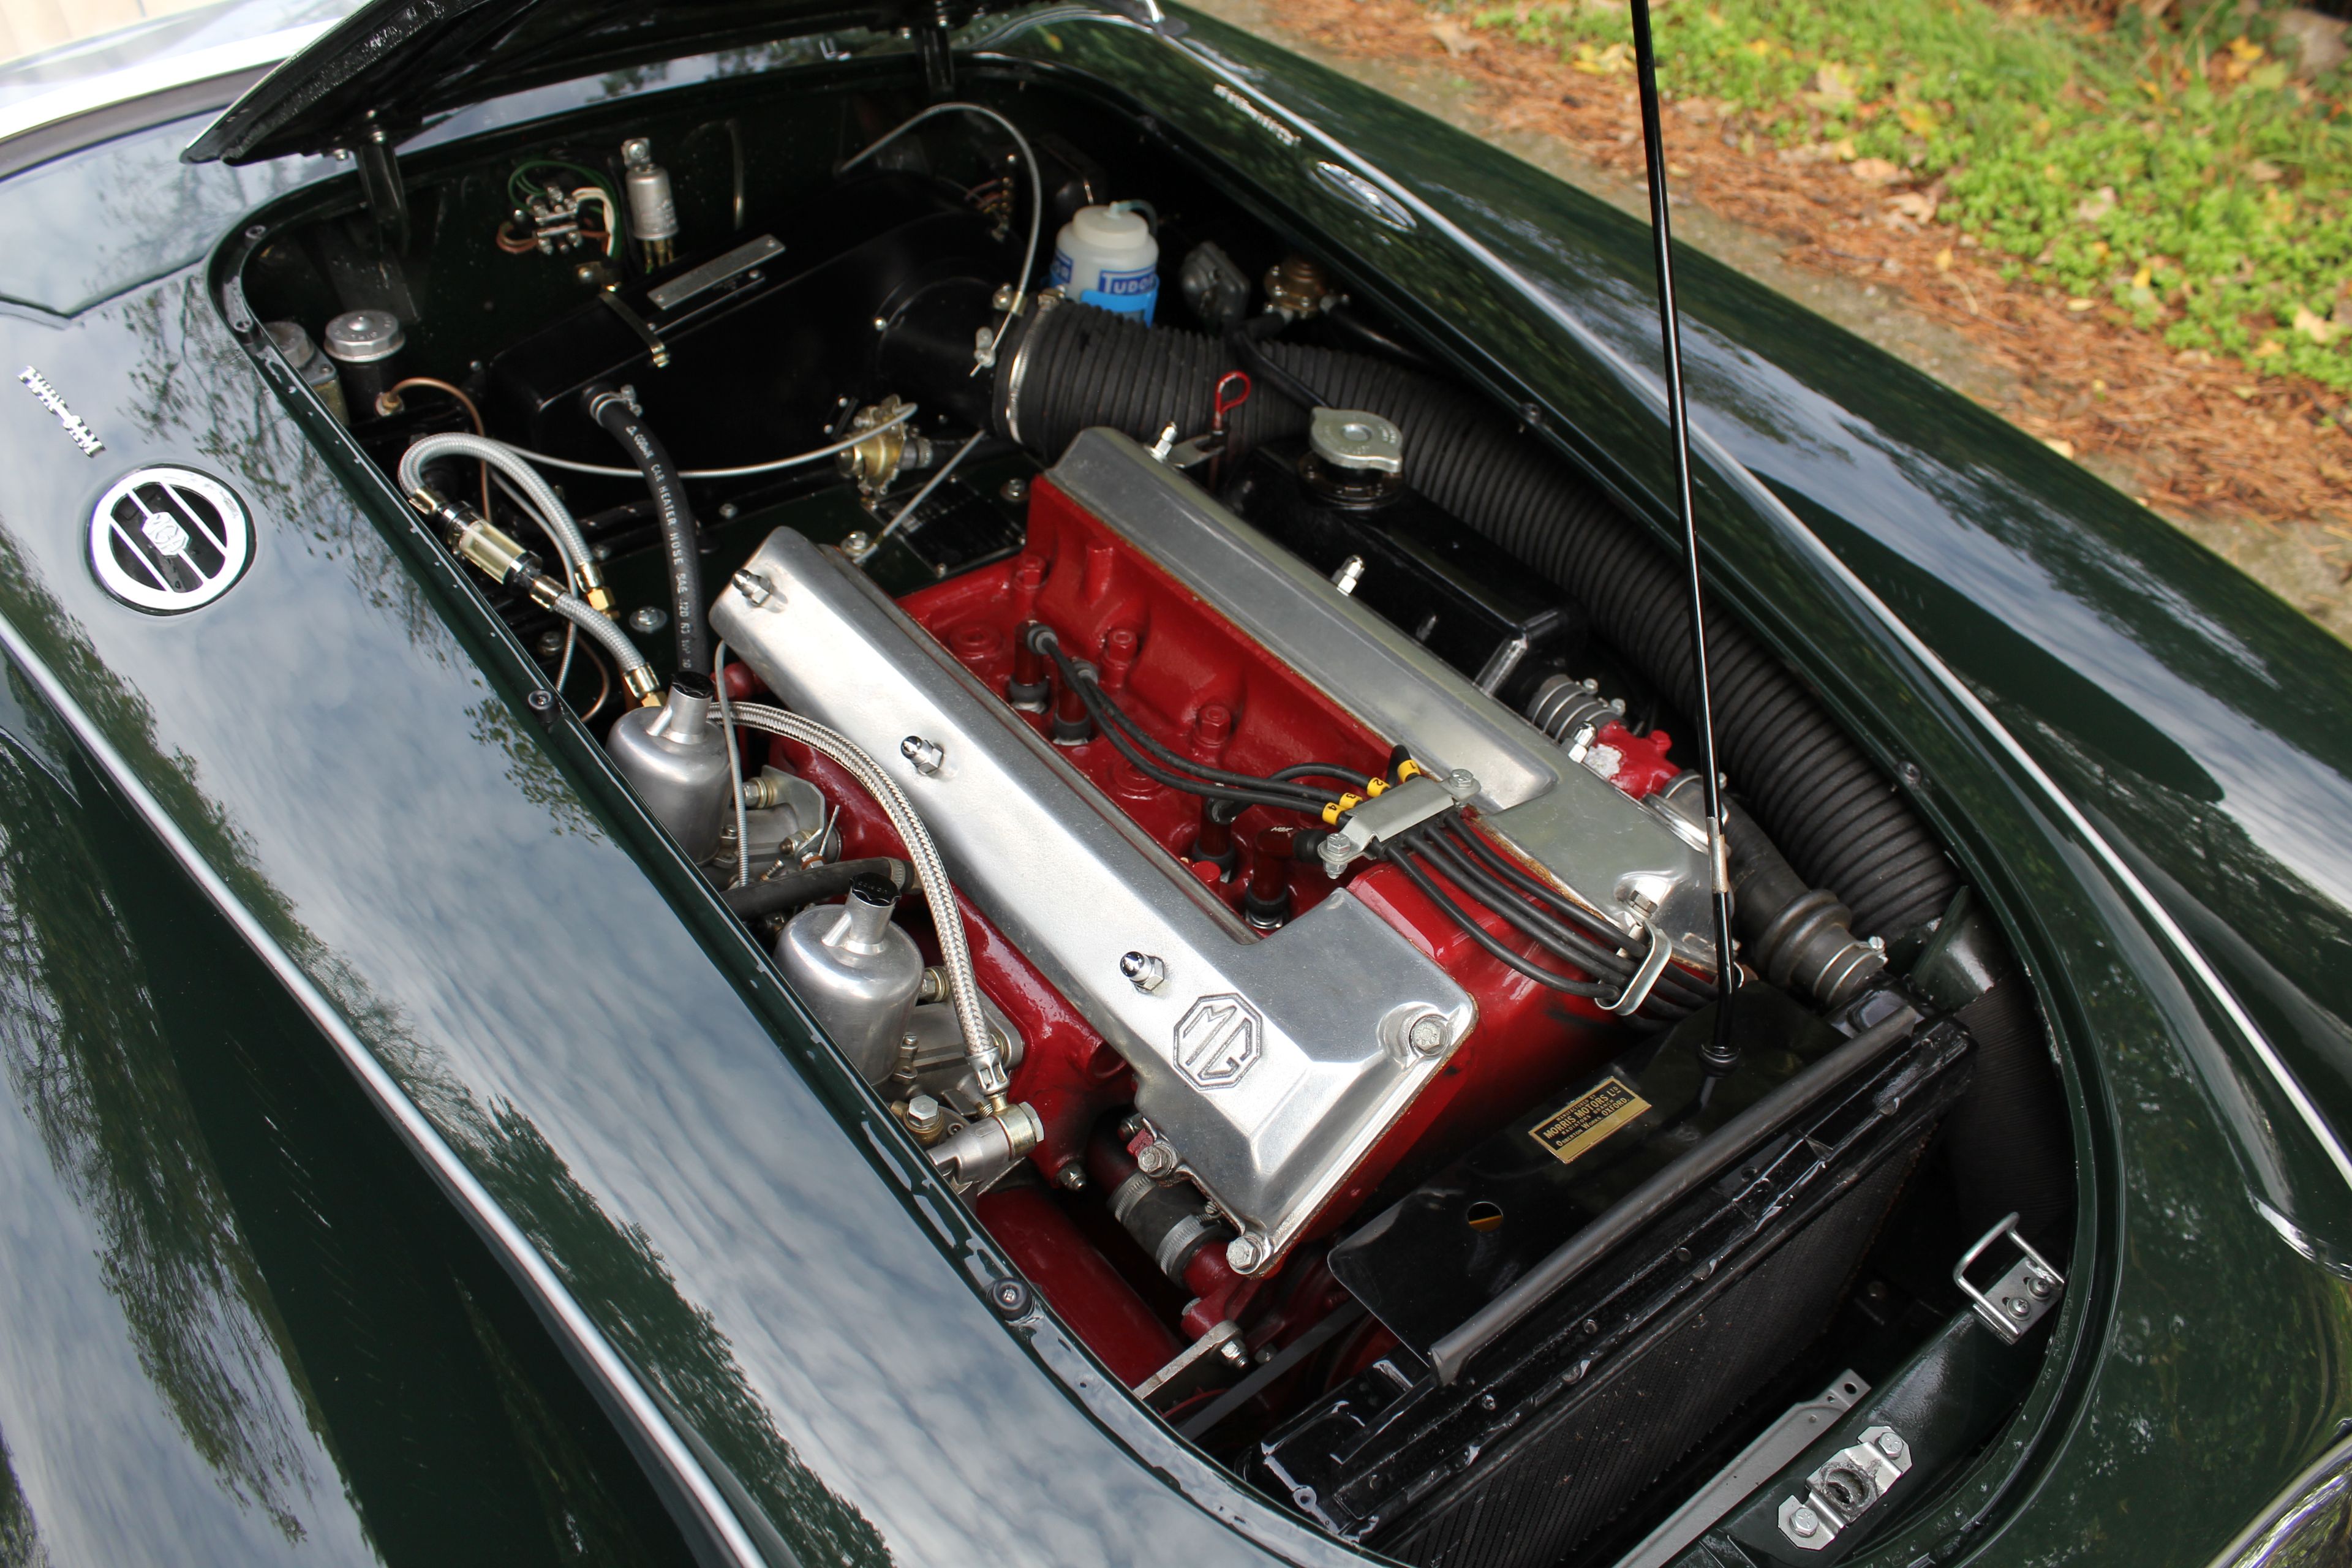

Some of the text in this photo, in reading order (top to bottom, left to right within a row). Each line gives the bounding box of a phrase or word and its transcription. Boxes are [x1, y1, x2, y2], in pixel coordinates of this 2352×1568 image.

[145, 513, 187, 553] MGA
[650, 464, 666, 483] CAR
[658, 485, 677, 526] HEATER
[669, 532, 684, 565] HOSE
[1373, 778, 1384, 787] 2
[1183, 1005, 1253, 1080] MG
[1543, 1115, 1577, 1139] MORRIS
[1574, 1094, 1609, 1119] MOTORS
[1556, 1098, 1589, 1121] MANUFACTURED
[1561, 1099, 1615, 1136] RADIATORS BRANCH
